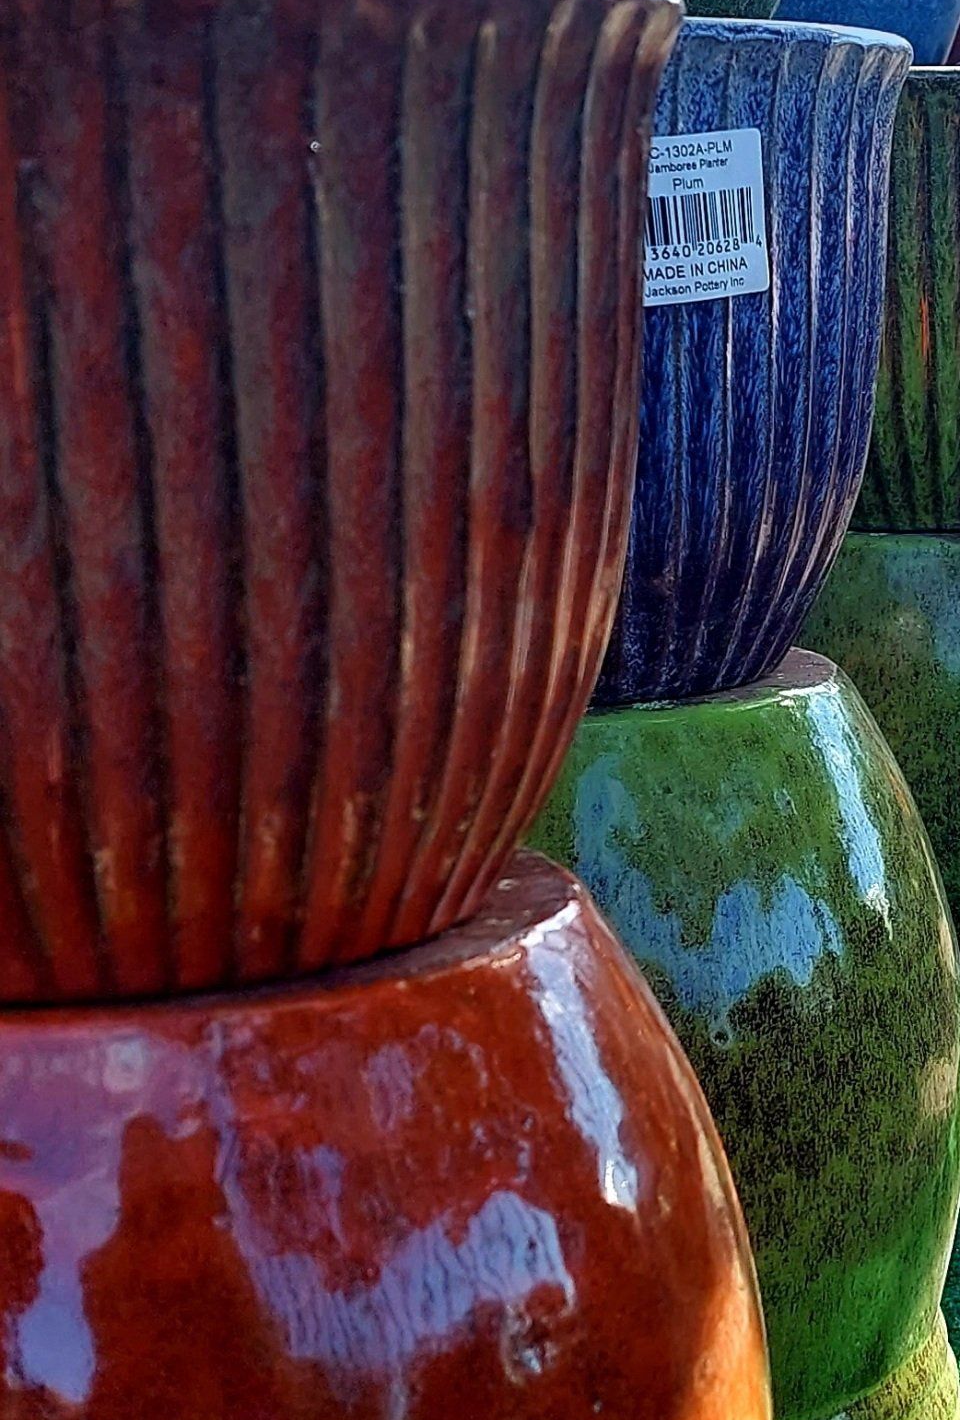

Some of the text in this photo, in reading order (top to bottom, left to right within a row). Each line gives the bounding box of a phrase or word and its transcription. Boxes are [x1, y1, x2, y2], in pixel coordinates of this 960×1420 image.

[648, 158, 728, 173] Jamboree Planter
[673, 178, 704, 191] Plum
[698, 238, 740, 256] 20628
[756, 235, 762, 247] 4
[644, 257, 748, 281] MADE IN CHINA
[645, 277, 744, 298] Jackson Pottery Inc
